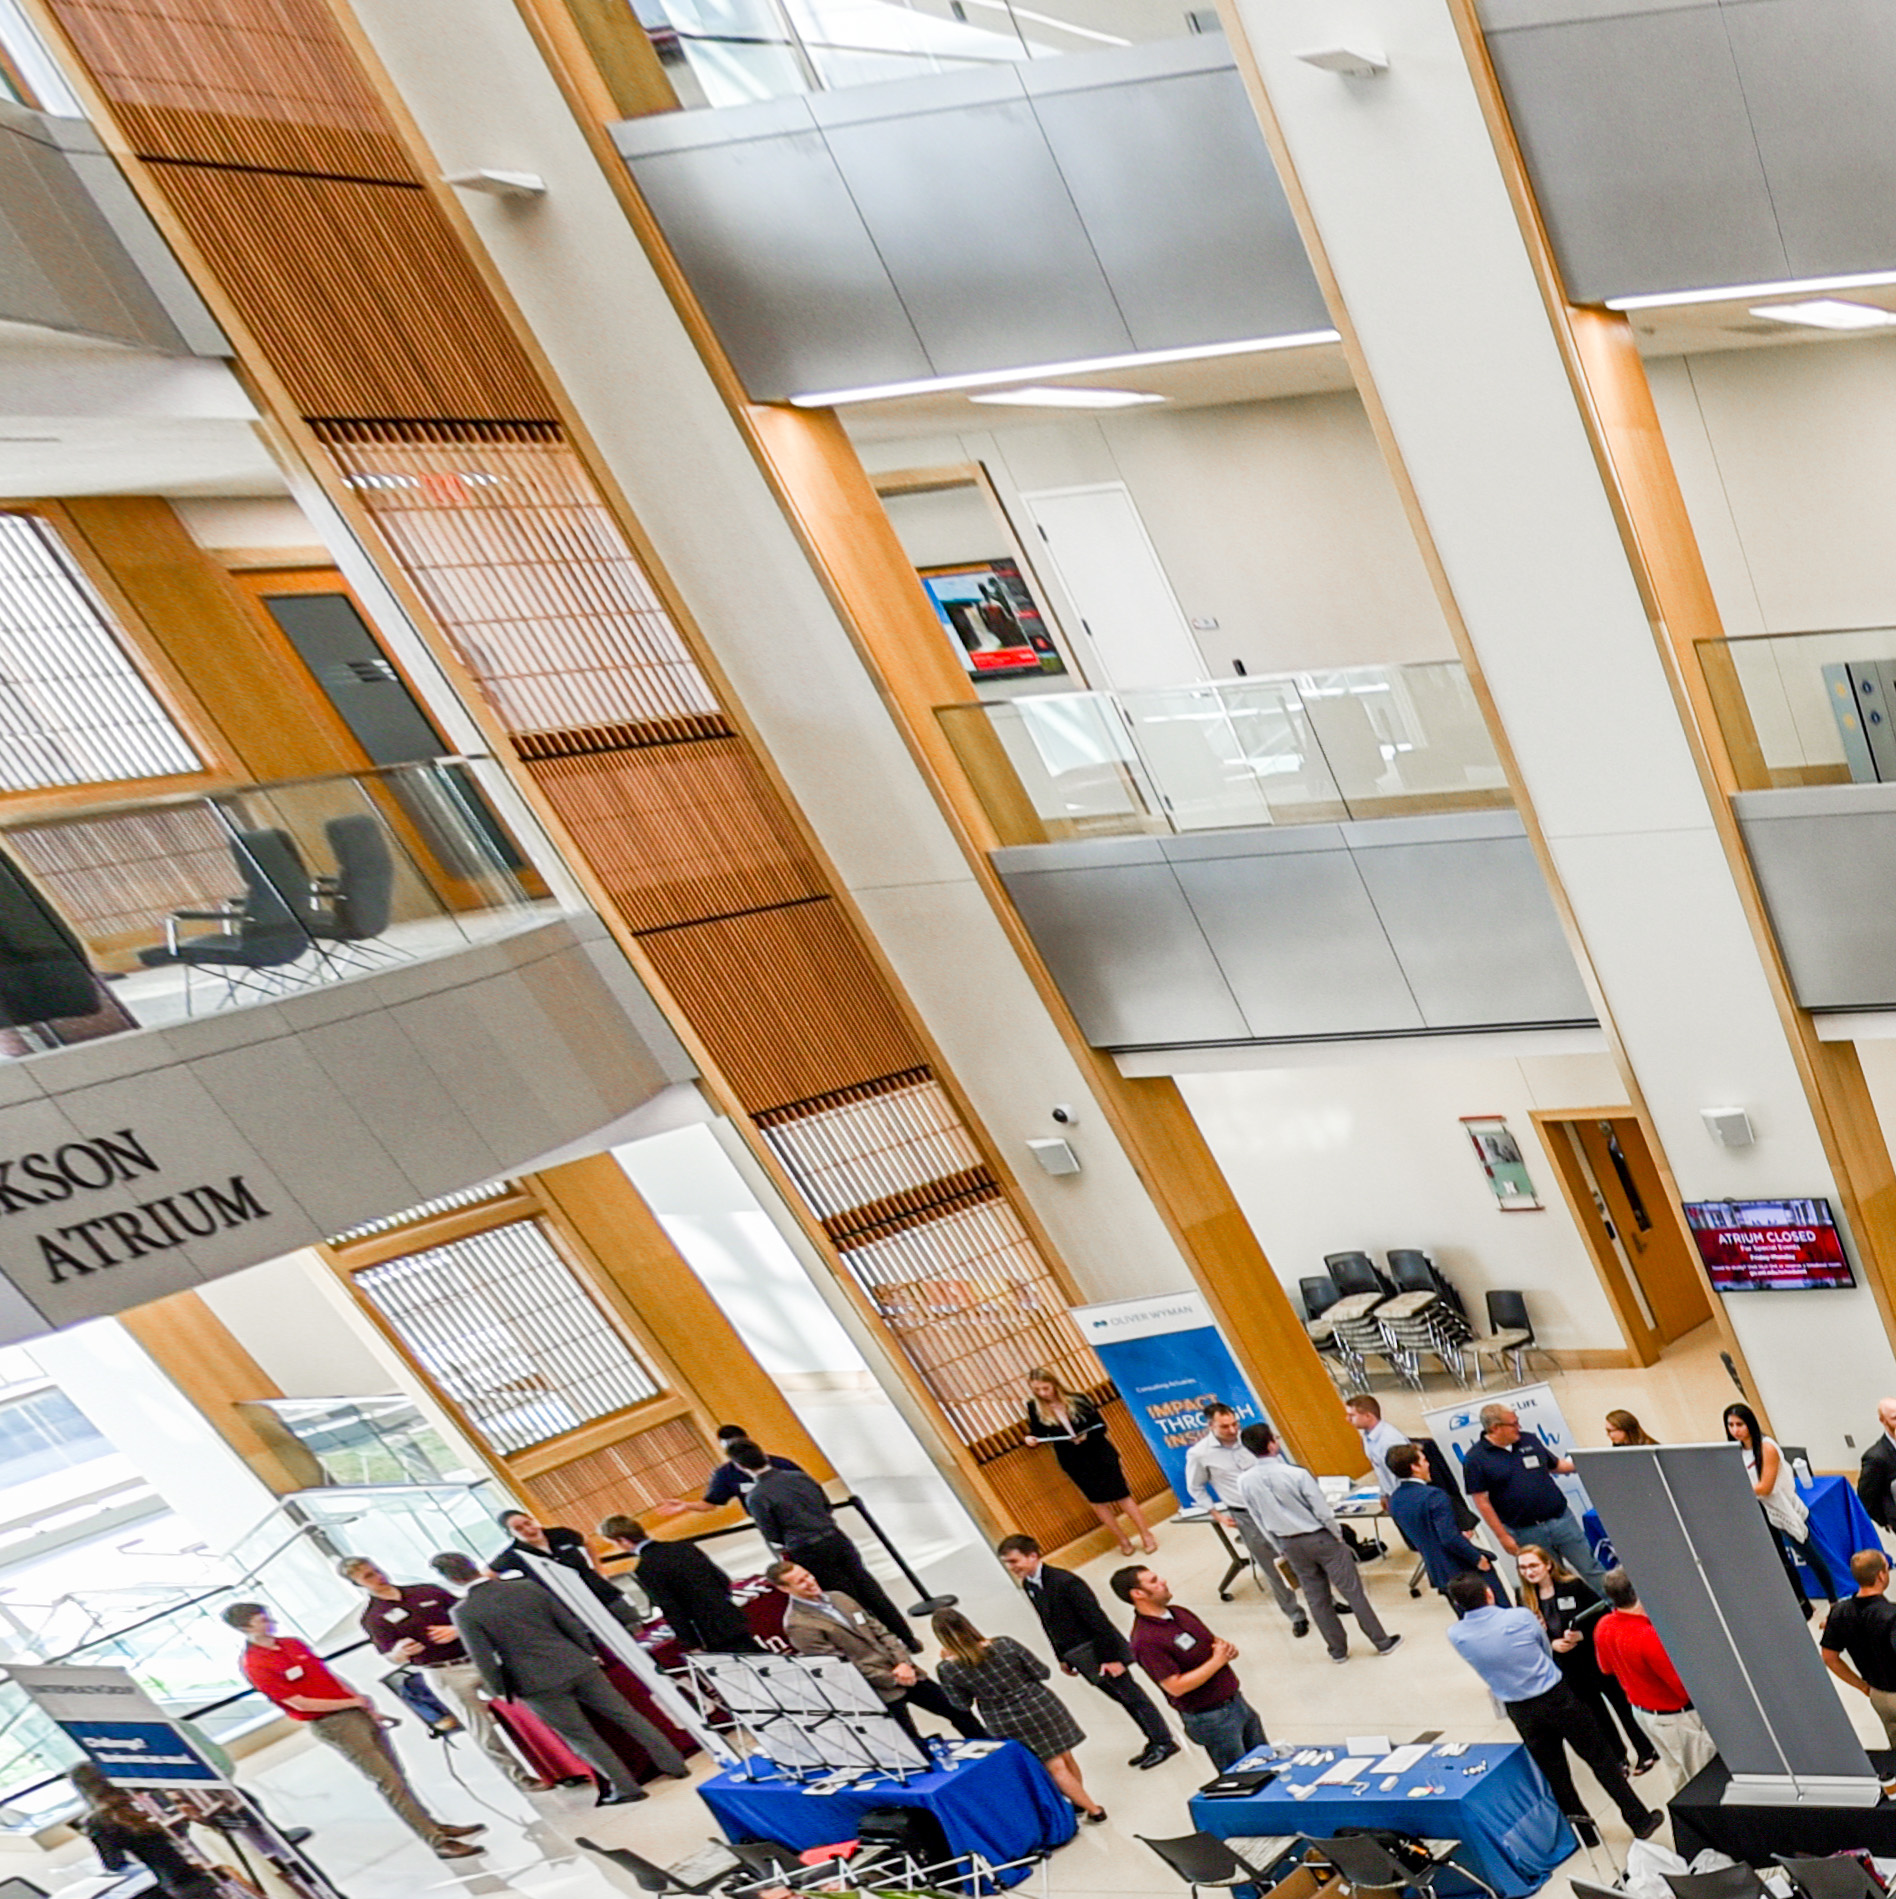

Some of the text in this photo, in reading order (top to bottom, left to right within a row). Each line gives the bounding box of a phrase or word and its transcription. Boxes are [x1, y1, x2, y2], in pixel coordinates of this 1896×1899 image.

[36, 1175, 272, 1284] ATRIUM
[1718, 1230, 1817, 1246] ATRIUM CLOSED
[1110, 1305, 1193, 1327] OLIVER WYMAN
